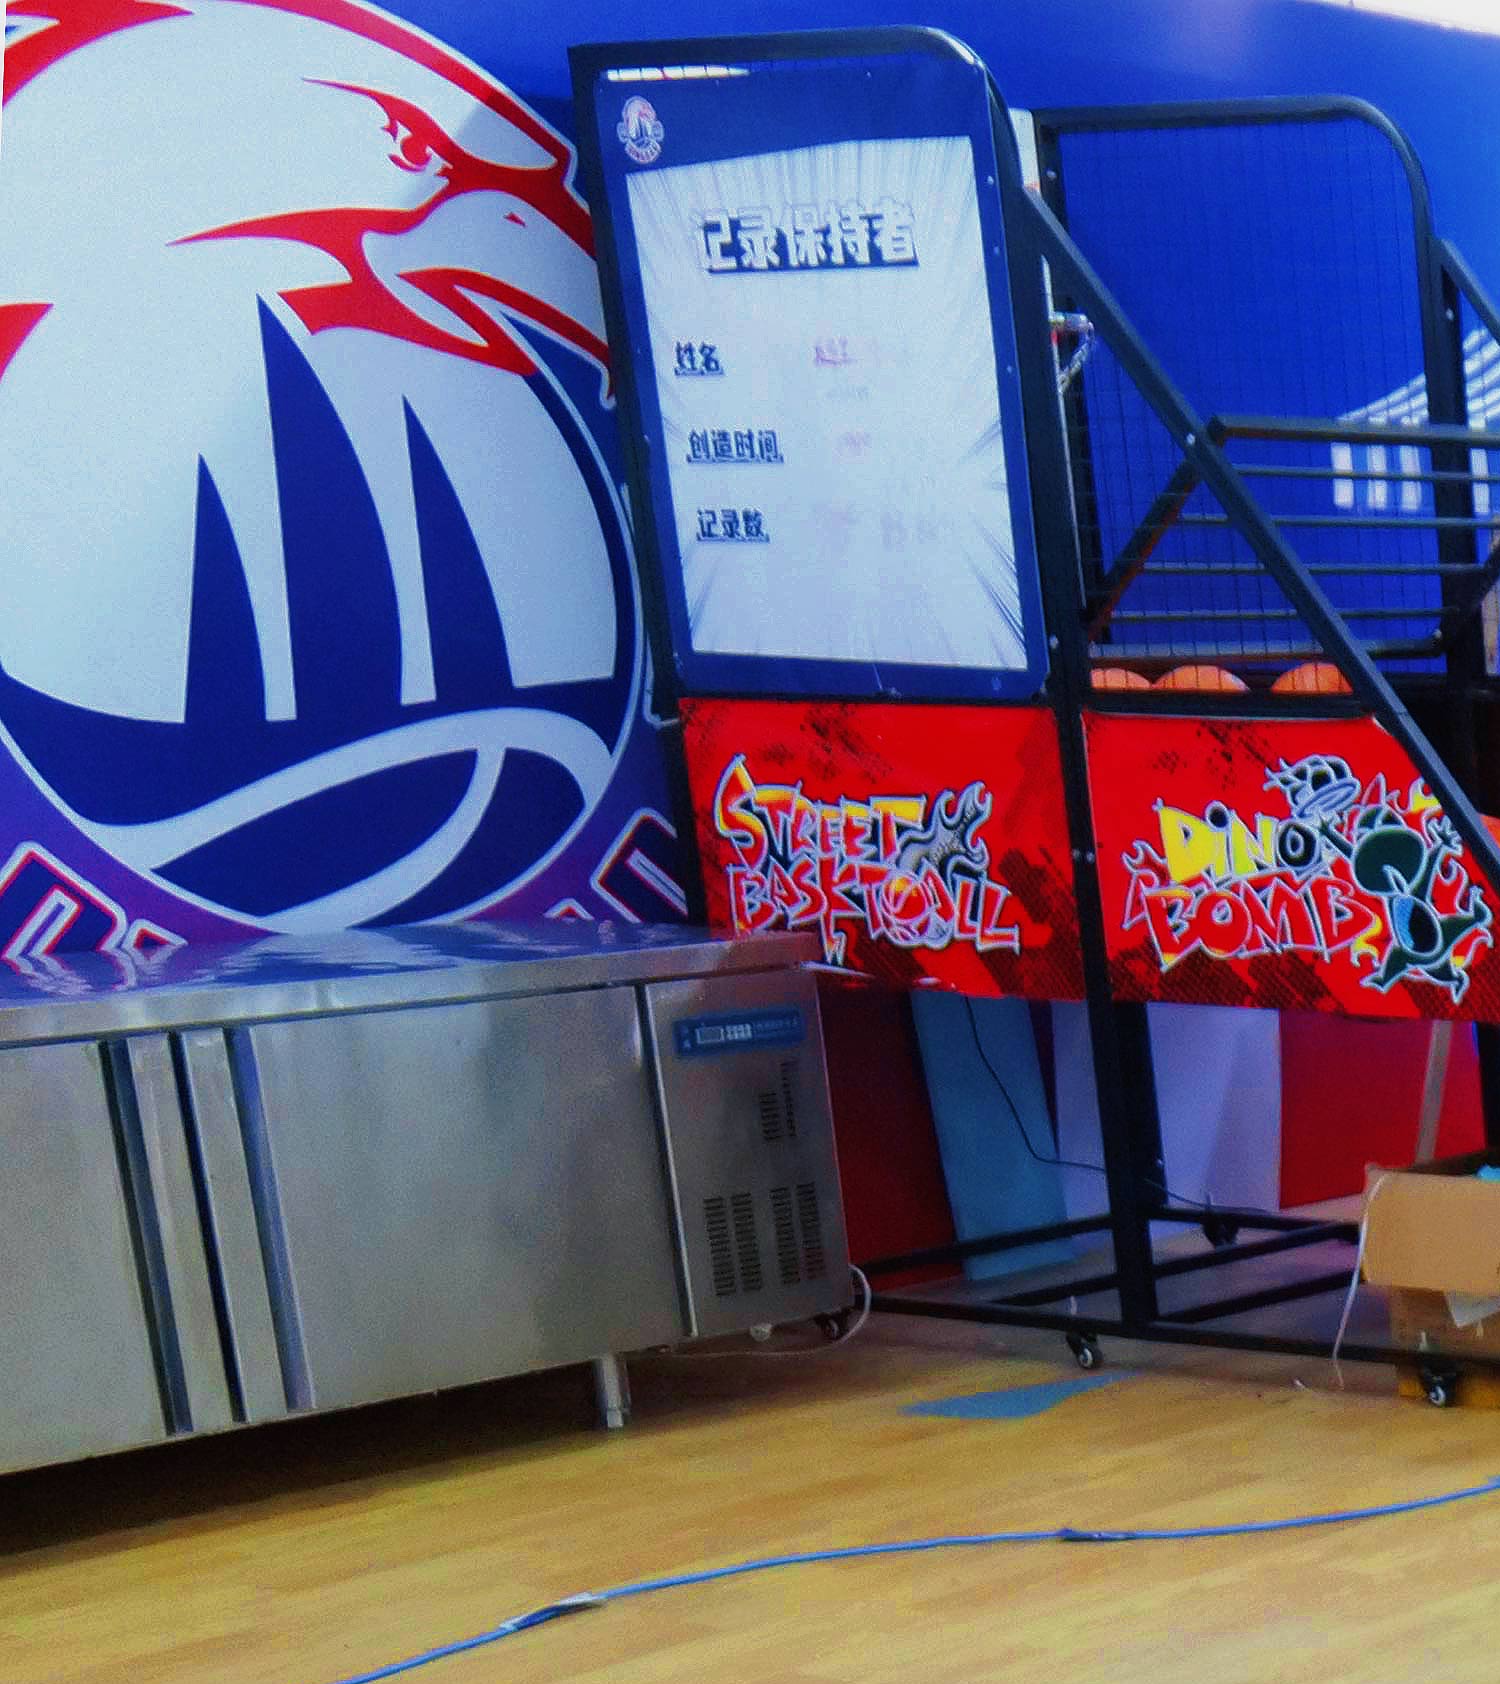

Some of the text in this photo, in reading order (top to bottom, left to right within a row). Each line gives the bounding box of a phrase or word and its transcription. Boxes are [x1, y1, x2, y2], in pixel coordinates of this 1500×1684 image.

[697, 202, 919, 271] 记录保持者
[674, 340, 724, 376] 姓名
[686, 427, 785, 464] 创造时间
[696, 507, 770, 543] 记录数
[714, 754, 926, 868] STREET
[1144, 868, 1376, 974] BOMB
